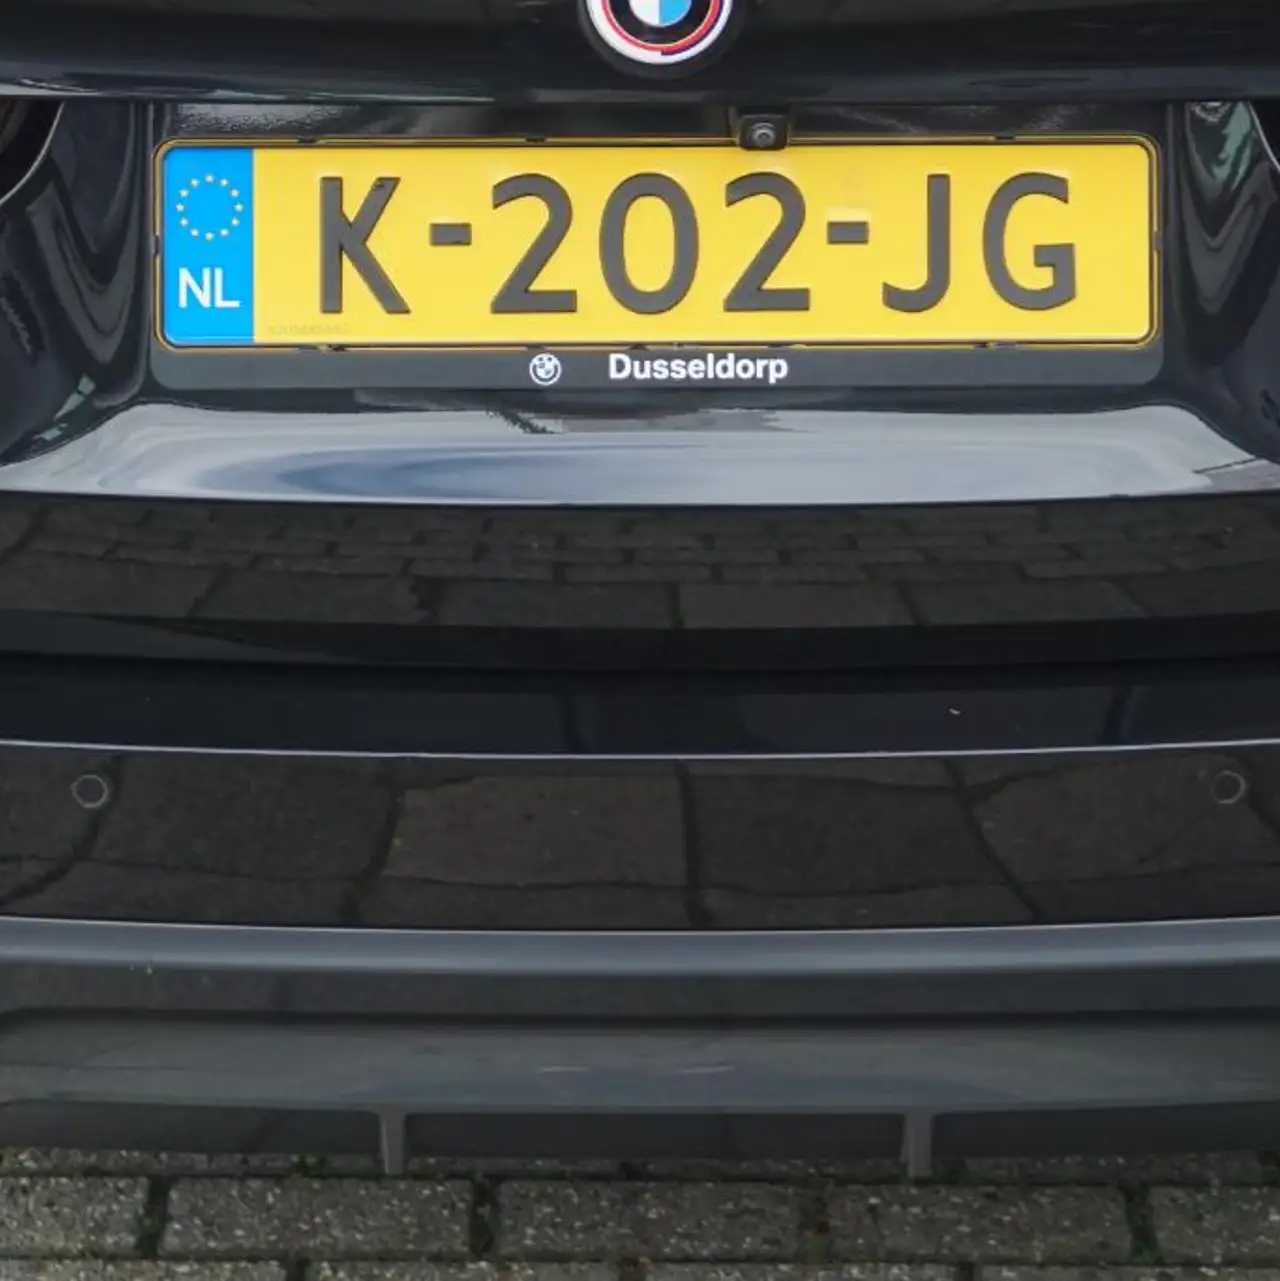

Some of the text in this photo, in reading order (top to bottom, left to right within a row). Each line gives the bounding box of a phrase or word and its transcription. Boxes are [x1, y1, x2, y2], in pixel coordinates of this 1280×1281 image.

[320, 172, 1078, 316] K-202-JG
[178, 267, 240, 308] NL
[608, 352, 789, 384] Dusseldorp
